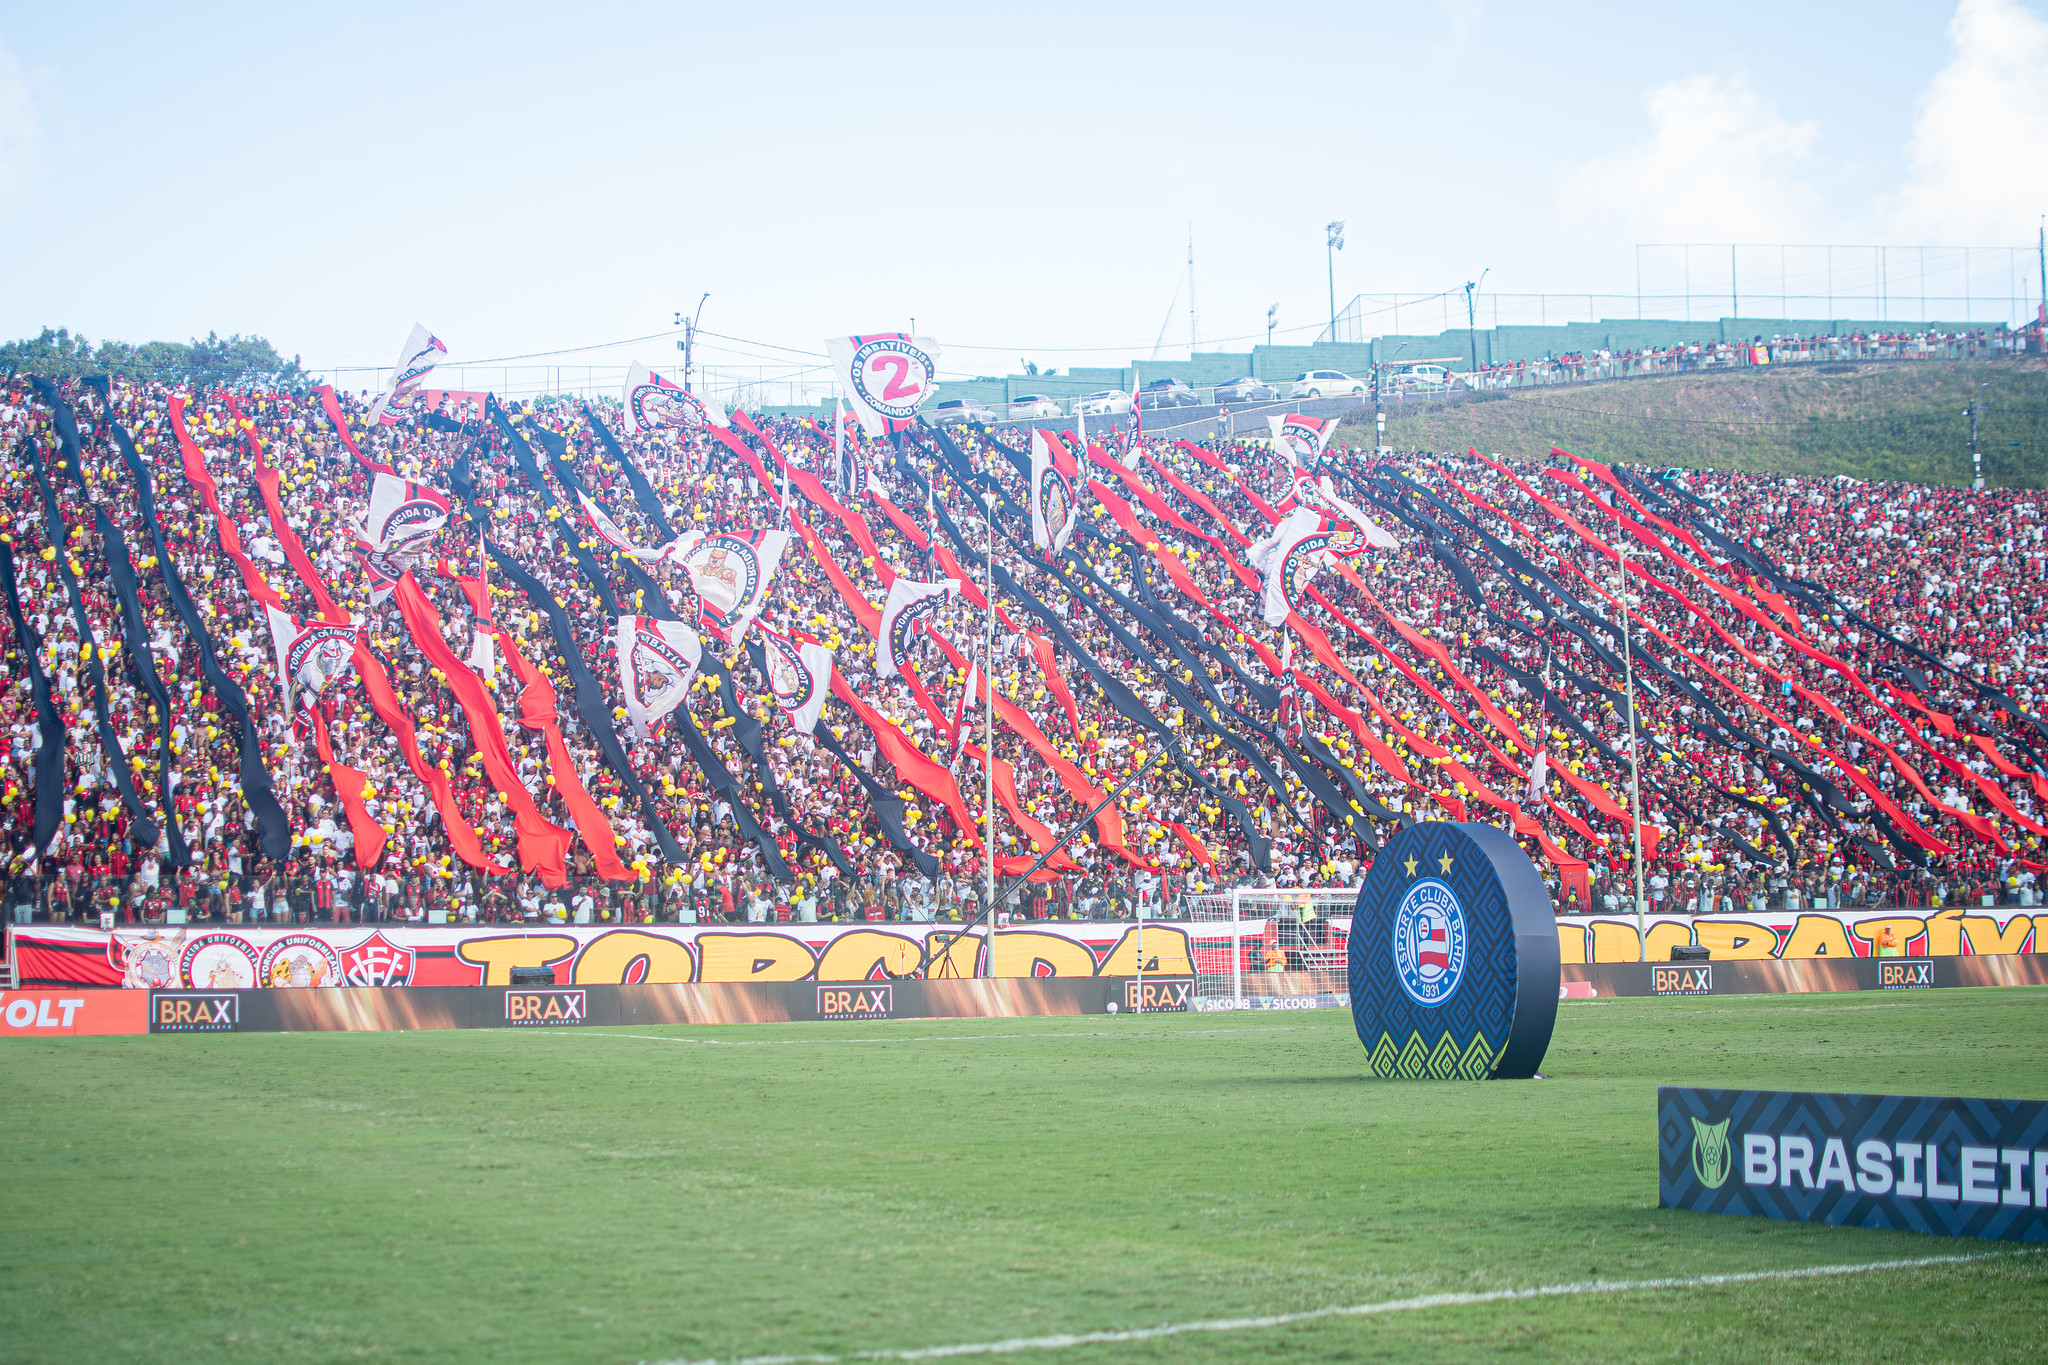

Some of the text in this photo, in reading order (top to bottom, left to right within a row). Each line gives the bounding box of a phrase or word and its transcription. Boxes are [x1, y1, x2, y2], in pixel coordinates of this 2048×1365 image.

[852, 340, 927, 377] OS IMBATÍVEIS
[864, 394, 913, 416] COMANDO
[386, 507, 420, 539] TORCIDA
[896, 600, 930, 629] TORCIDA
[290, 635, 319, 671] TORCIDA
[1399, 888, 1462, 976] ESPORTE CLUBE BAHIA
[182, 940, 205, 973] TORCIDA
[261, 943, 286, 978] TORCIDA
[1656, 969, 1709, 991] BRAX
[1884, 965, 1929, 984] BRAX
[824, 990, 885, 1014] BRAX
[1129, 984, 1190, 1008] BRAX
[1421, 984, 1440, 998] 1931
[0, 992, 84, 1028] OLT
[160, 1000, 231, 1023] BRAX
[510, 995, 581, 1020] BRAX
[1206, 998, 1251, 1011] SICOB
[1273, 998, 1317, 1010] SICOOB
